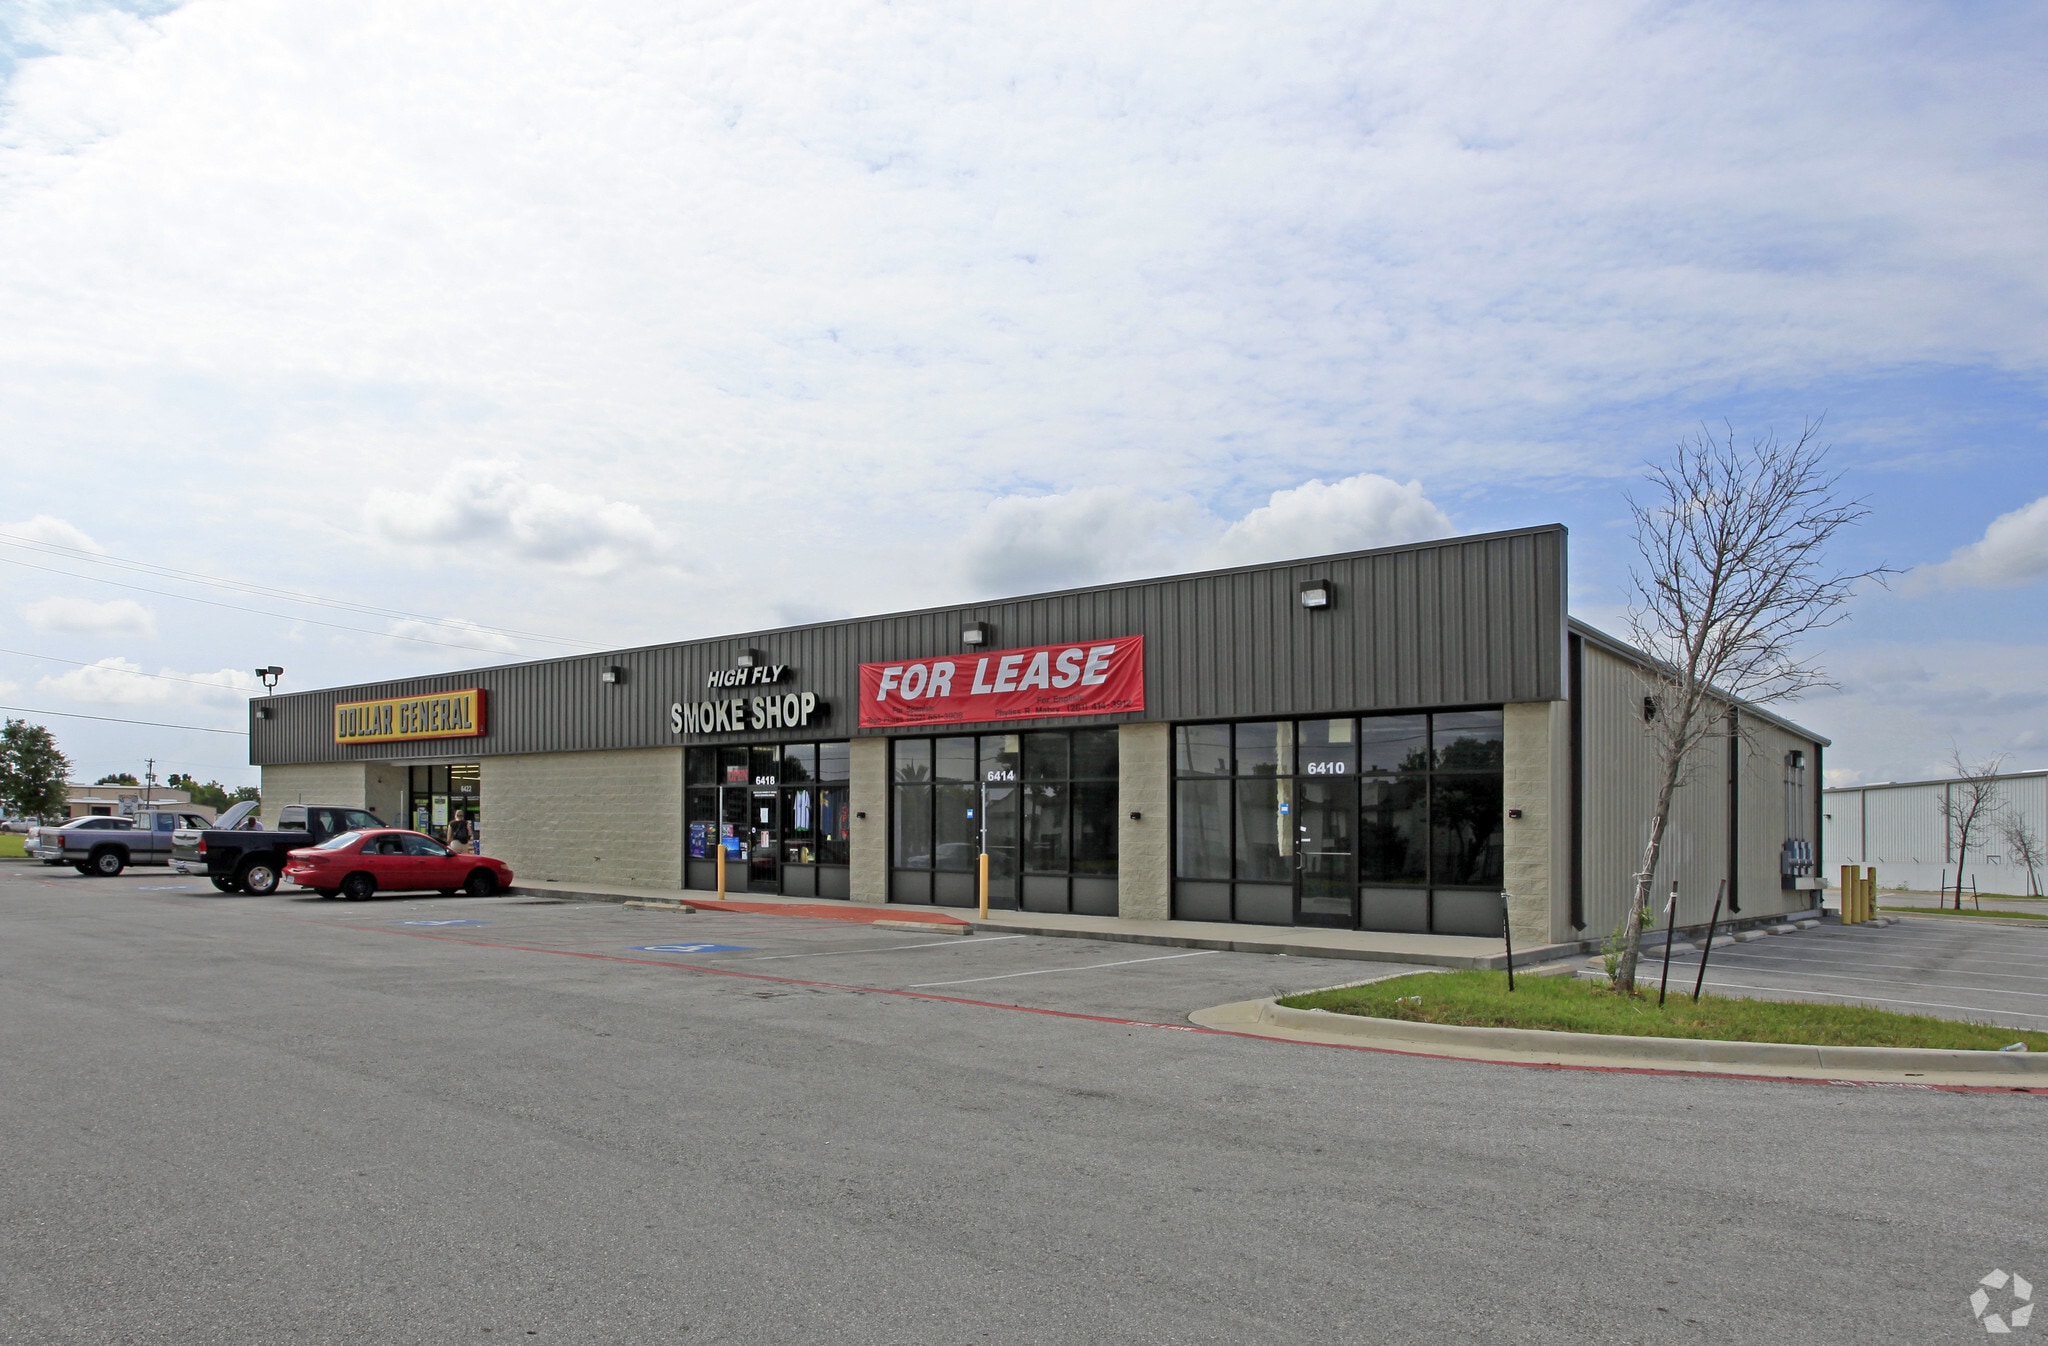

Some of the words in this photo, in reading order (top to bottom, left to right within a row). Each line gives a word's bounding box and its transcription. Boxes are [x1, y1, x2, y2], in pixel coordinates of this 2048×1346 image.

[707, 668, 748, 688] HIGH
[751, 665, 785, 685] FLY
[876, 661, 956, 702] FOR
[970, 644, 1116, 695] LEASE
[1037, 696, 1049, 704] For
[338, 704, 393, 738] DOLLAR
[399, 696, 472, 733] GENERAL
[671, 698, 745, 734] SMOKE
[751, 691, 816, 730] SHOP
[1307, 761, 1345, 775] 6410
[727, 769, 748, 782] OPEN
[755, 776, 775, 785] 6418
[987, 769, 1014, 782] 6414
